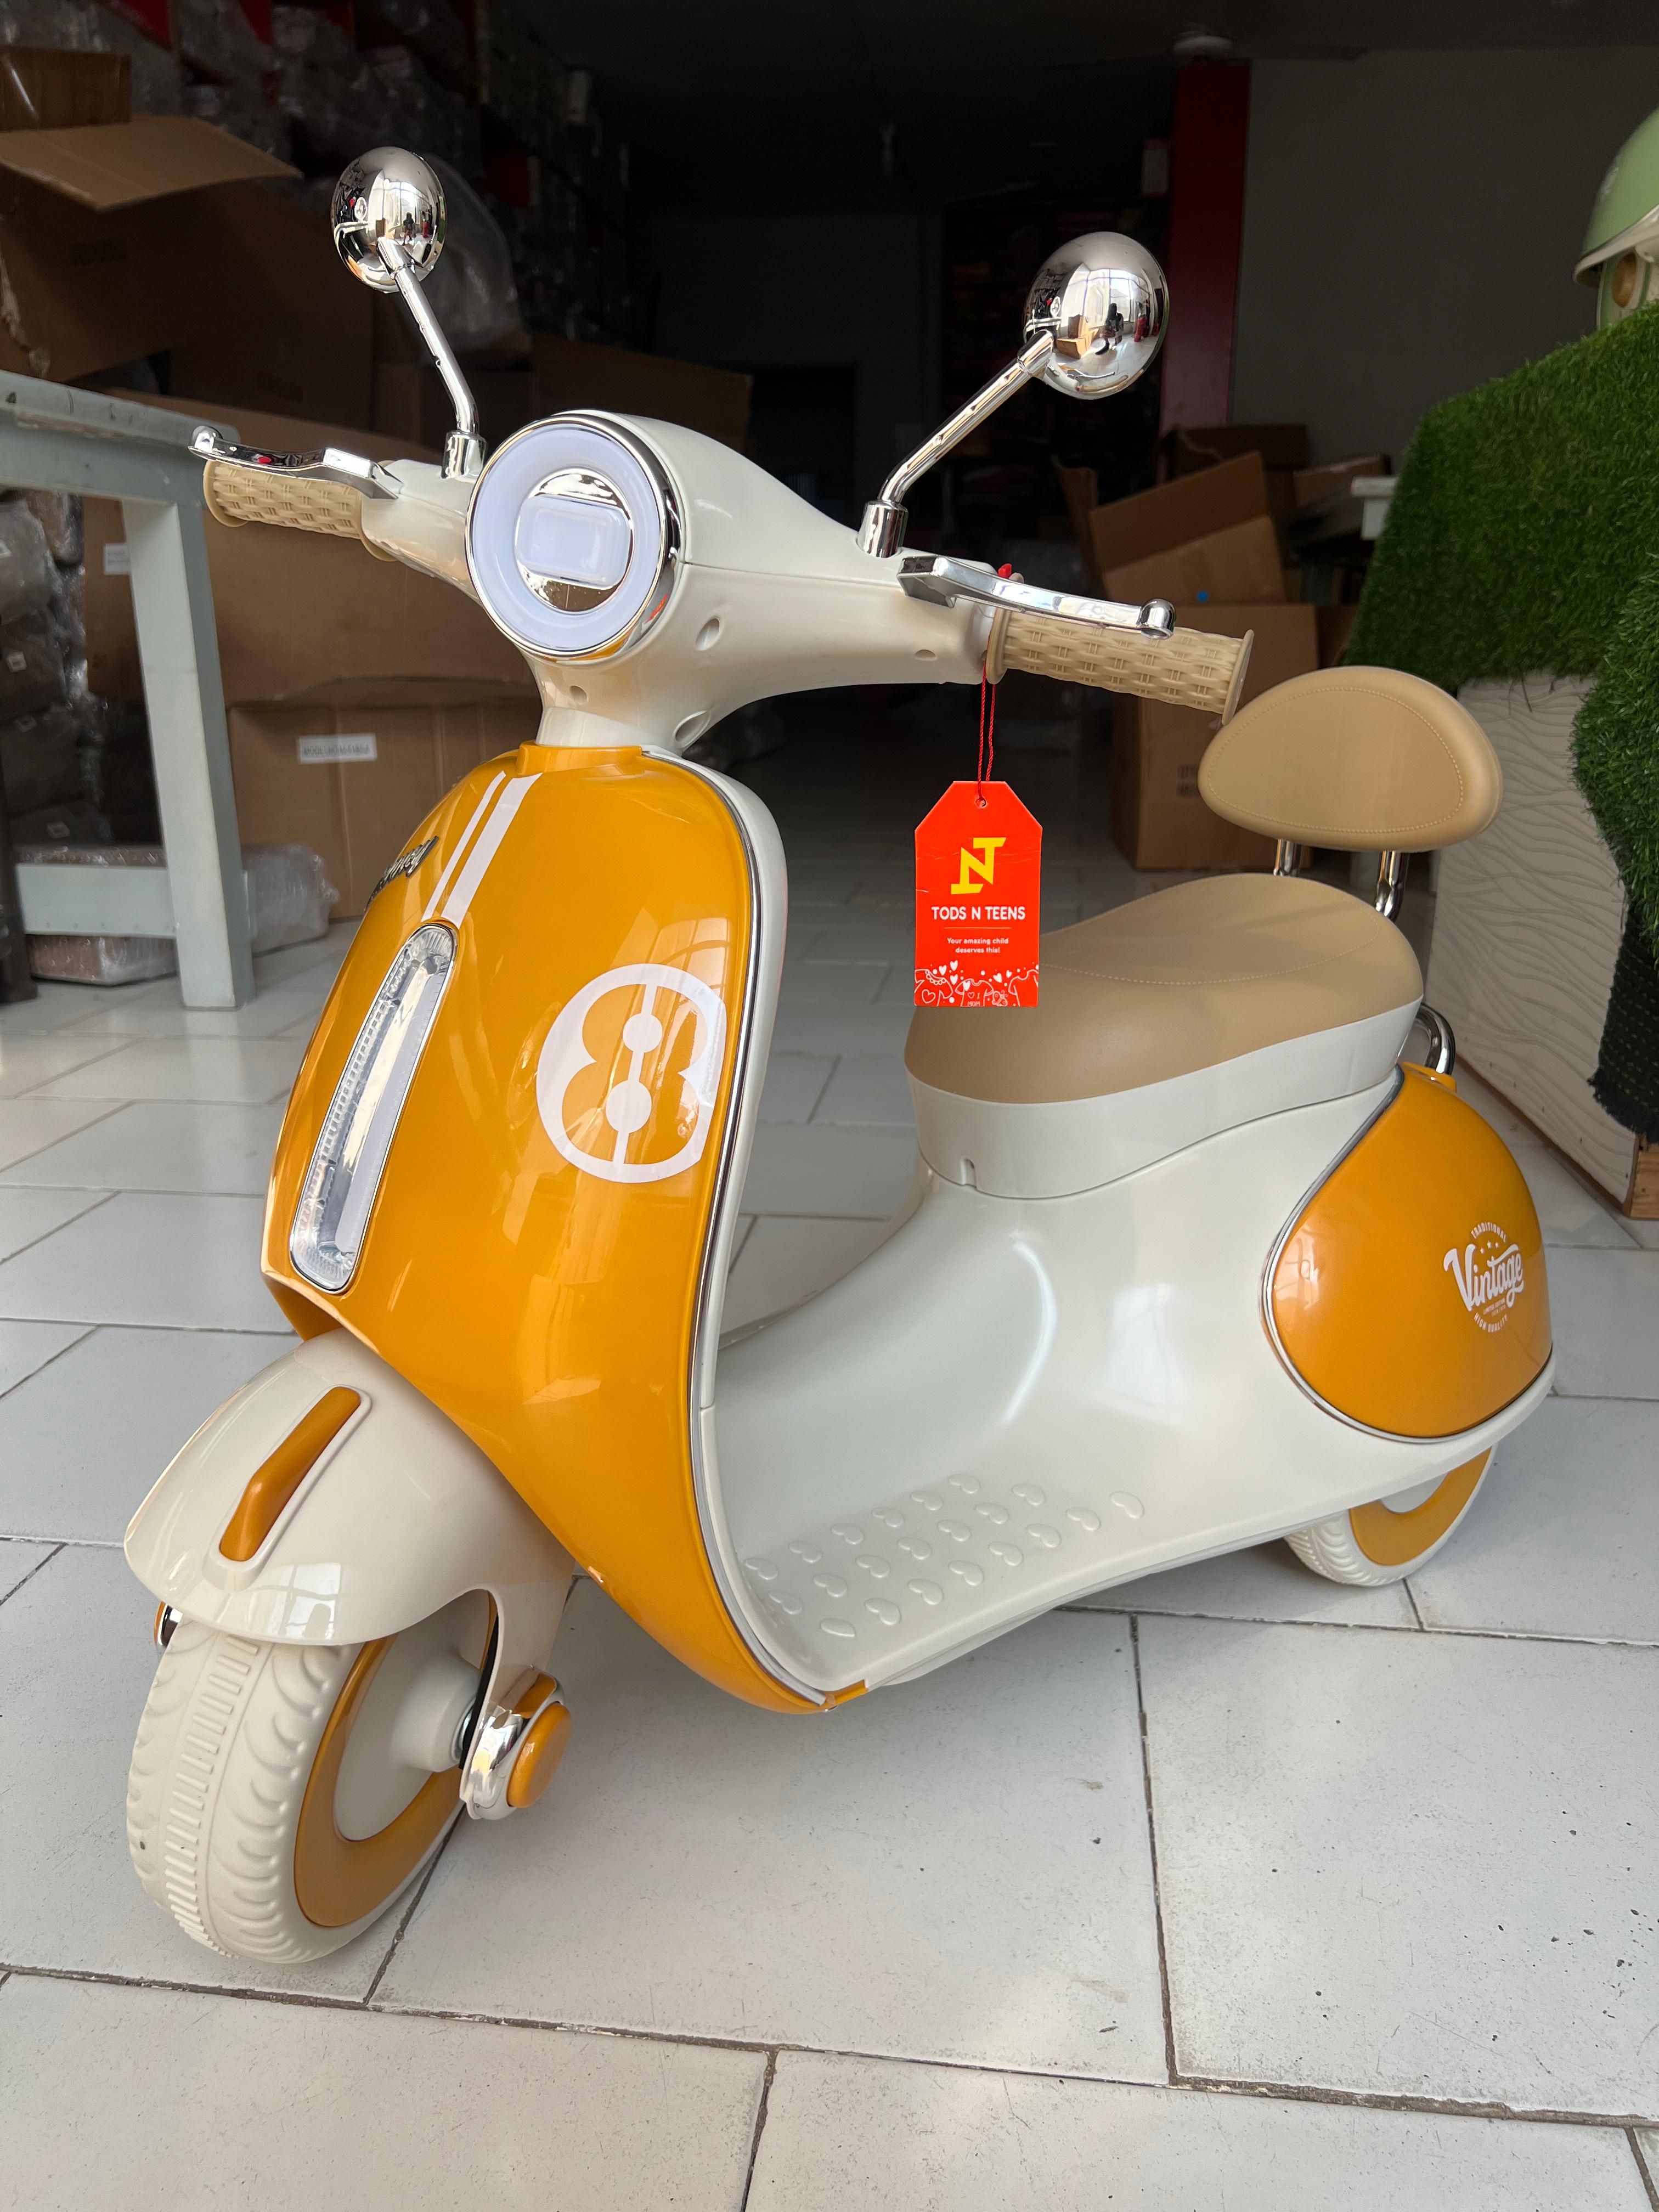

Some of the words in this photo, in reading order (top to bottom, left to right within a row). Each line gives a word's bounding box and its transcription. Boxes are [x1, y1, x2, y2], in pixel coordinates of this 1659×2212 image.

[931, 906, 967, 920] TODS
[972, 906, 981, 920] N
[985, 906, 1025, 920] TEENS
[1471, 1221, 1507, 1243] TRADITIONAL
[1443, 1244, 1524, 1311] Vintage
[1474, 1312, 1486, 1330] HIGH
[1487, 1314, 1508, 1333] QUALITY
